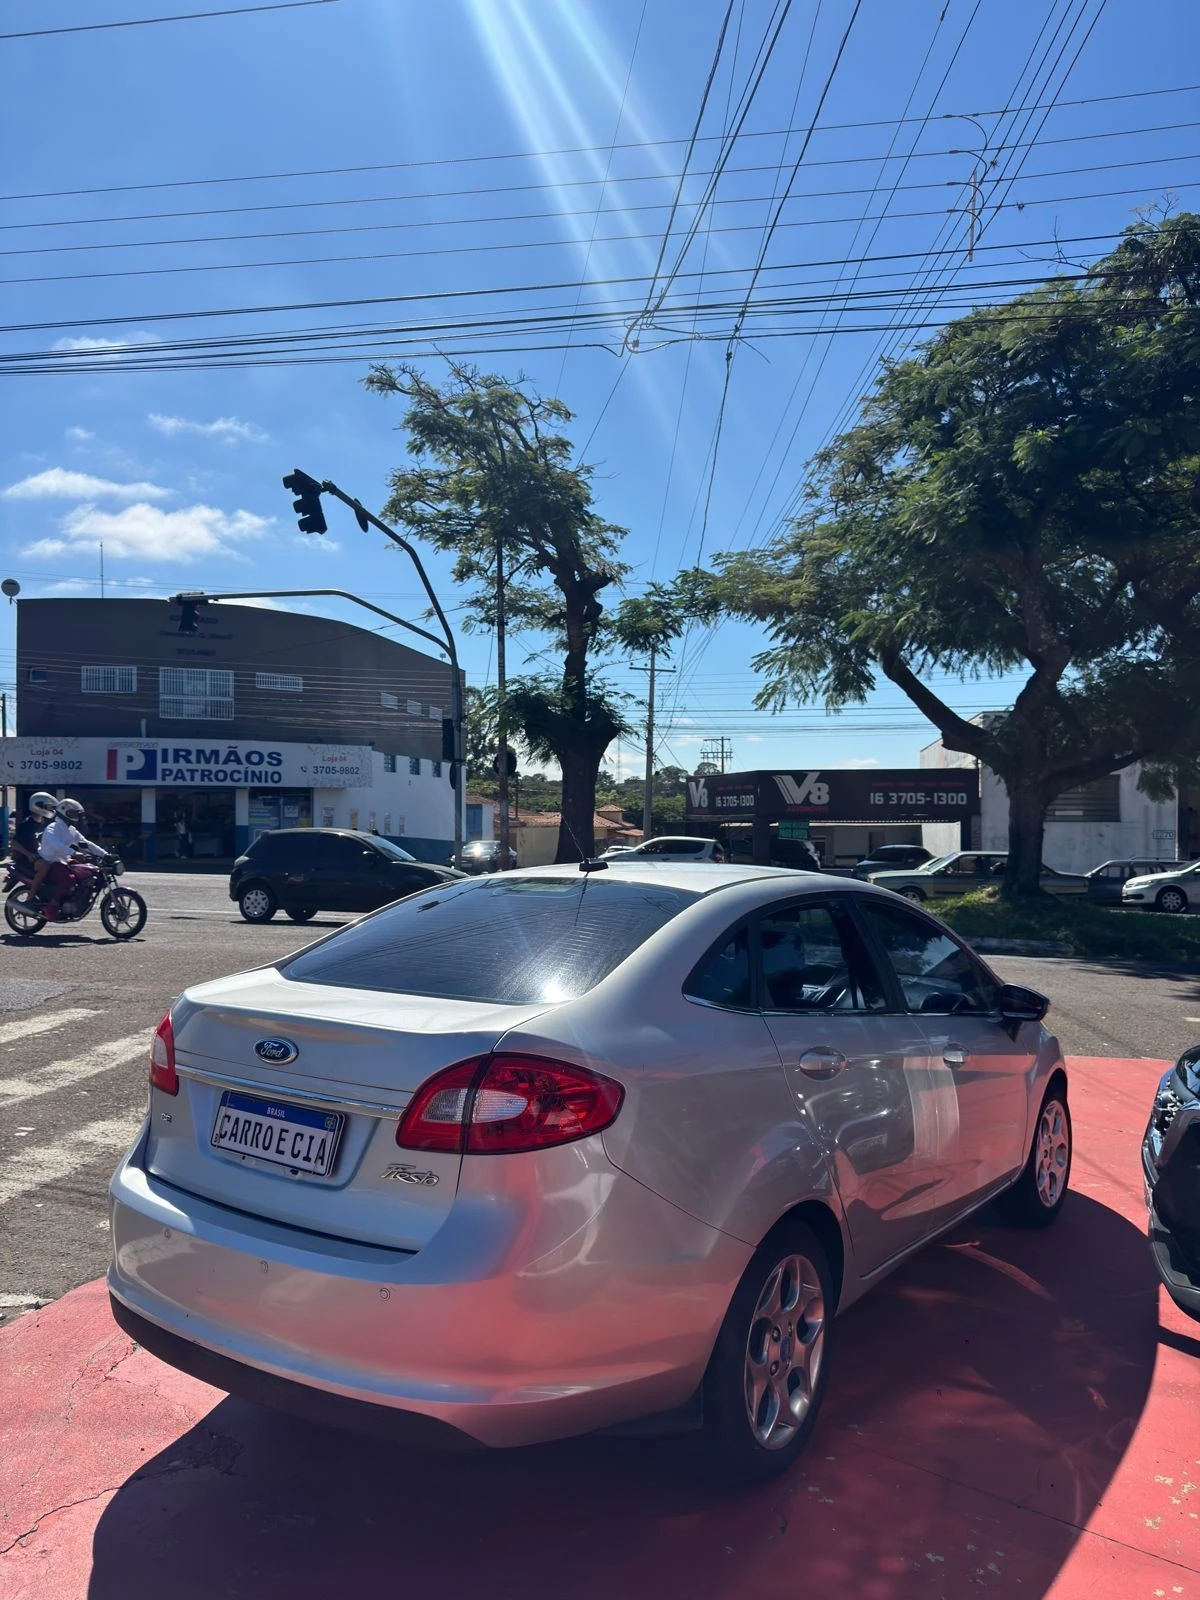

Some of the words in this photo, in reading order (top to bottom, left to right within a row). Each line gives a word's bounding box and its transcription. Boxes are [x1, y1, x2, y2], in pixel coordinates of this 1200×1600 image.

[30, 748, 50, 758] Loja
[52, 748, 64, 756] 04
[161, 746, 283, 766] IRMÃOS
[322, 754, 337, 763] Loja
[20, 760, 82, 770] 3705-9802
[313, 766, 360, 775] 3705-9802
[161, 767, 282, 784] PATROCÍNIO
[688, 778, 708, 808] V8
[771, 771, 830, 805] V8
[723, 795, 754, 807] 3705-1300
[870, 793, 885, 805] 16
[889, 792, 967, 805] 3705-1300
[260, 1041, 285, 1058] Ford
[266, 1106, 285, 1118] BRASIL
[380, 1163, 440, 1187] Fiesta
